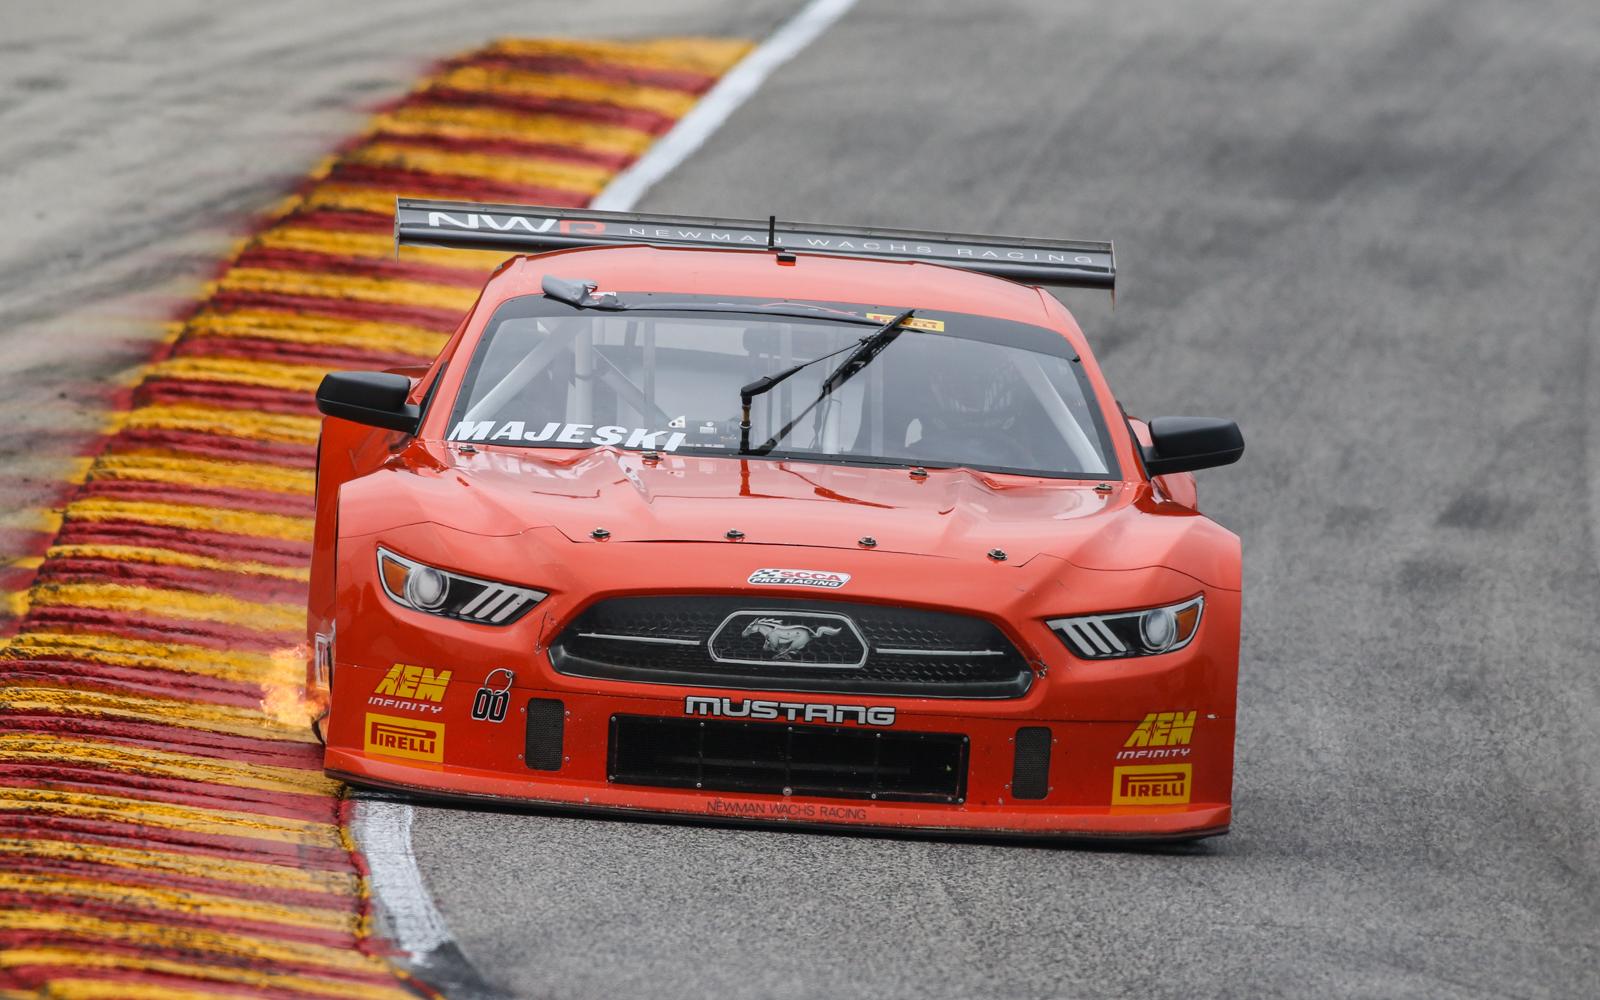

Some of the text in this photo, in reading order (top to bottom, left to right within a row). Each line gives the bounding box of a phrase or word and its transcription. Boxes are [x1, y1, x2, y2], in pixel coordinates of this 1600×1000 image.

[428, 211, 606, 235] NWR
[628, 227, 1093, 264] NEWMAN WACHS RACING
[448, 420, 686, 451] MAJESKI
[781, 571, 841, 581] SCCA
[784, 578, 839, 587] RACING
[374, 663, 452, 702] AEM
[368, 696, 443, 714] INFINITY
[685, 695, 896, 726] MUSTANG
[371, 721, 437, 754] PIRELLI
[1123, 710, 1197, 748] AEM
[1116, 748, 1191, 760] INFINITY
[1120, 772, 1186, 797] PIRELLI
[707, 800, 866, 820] NEWMAN WACHS RACING
